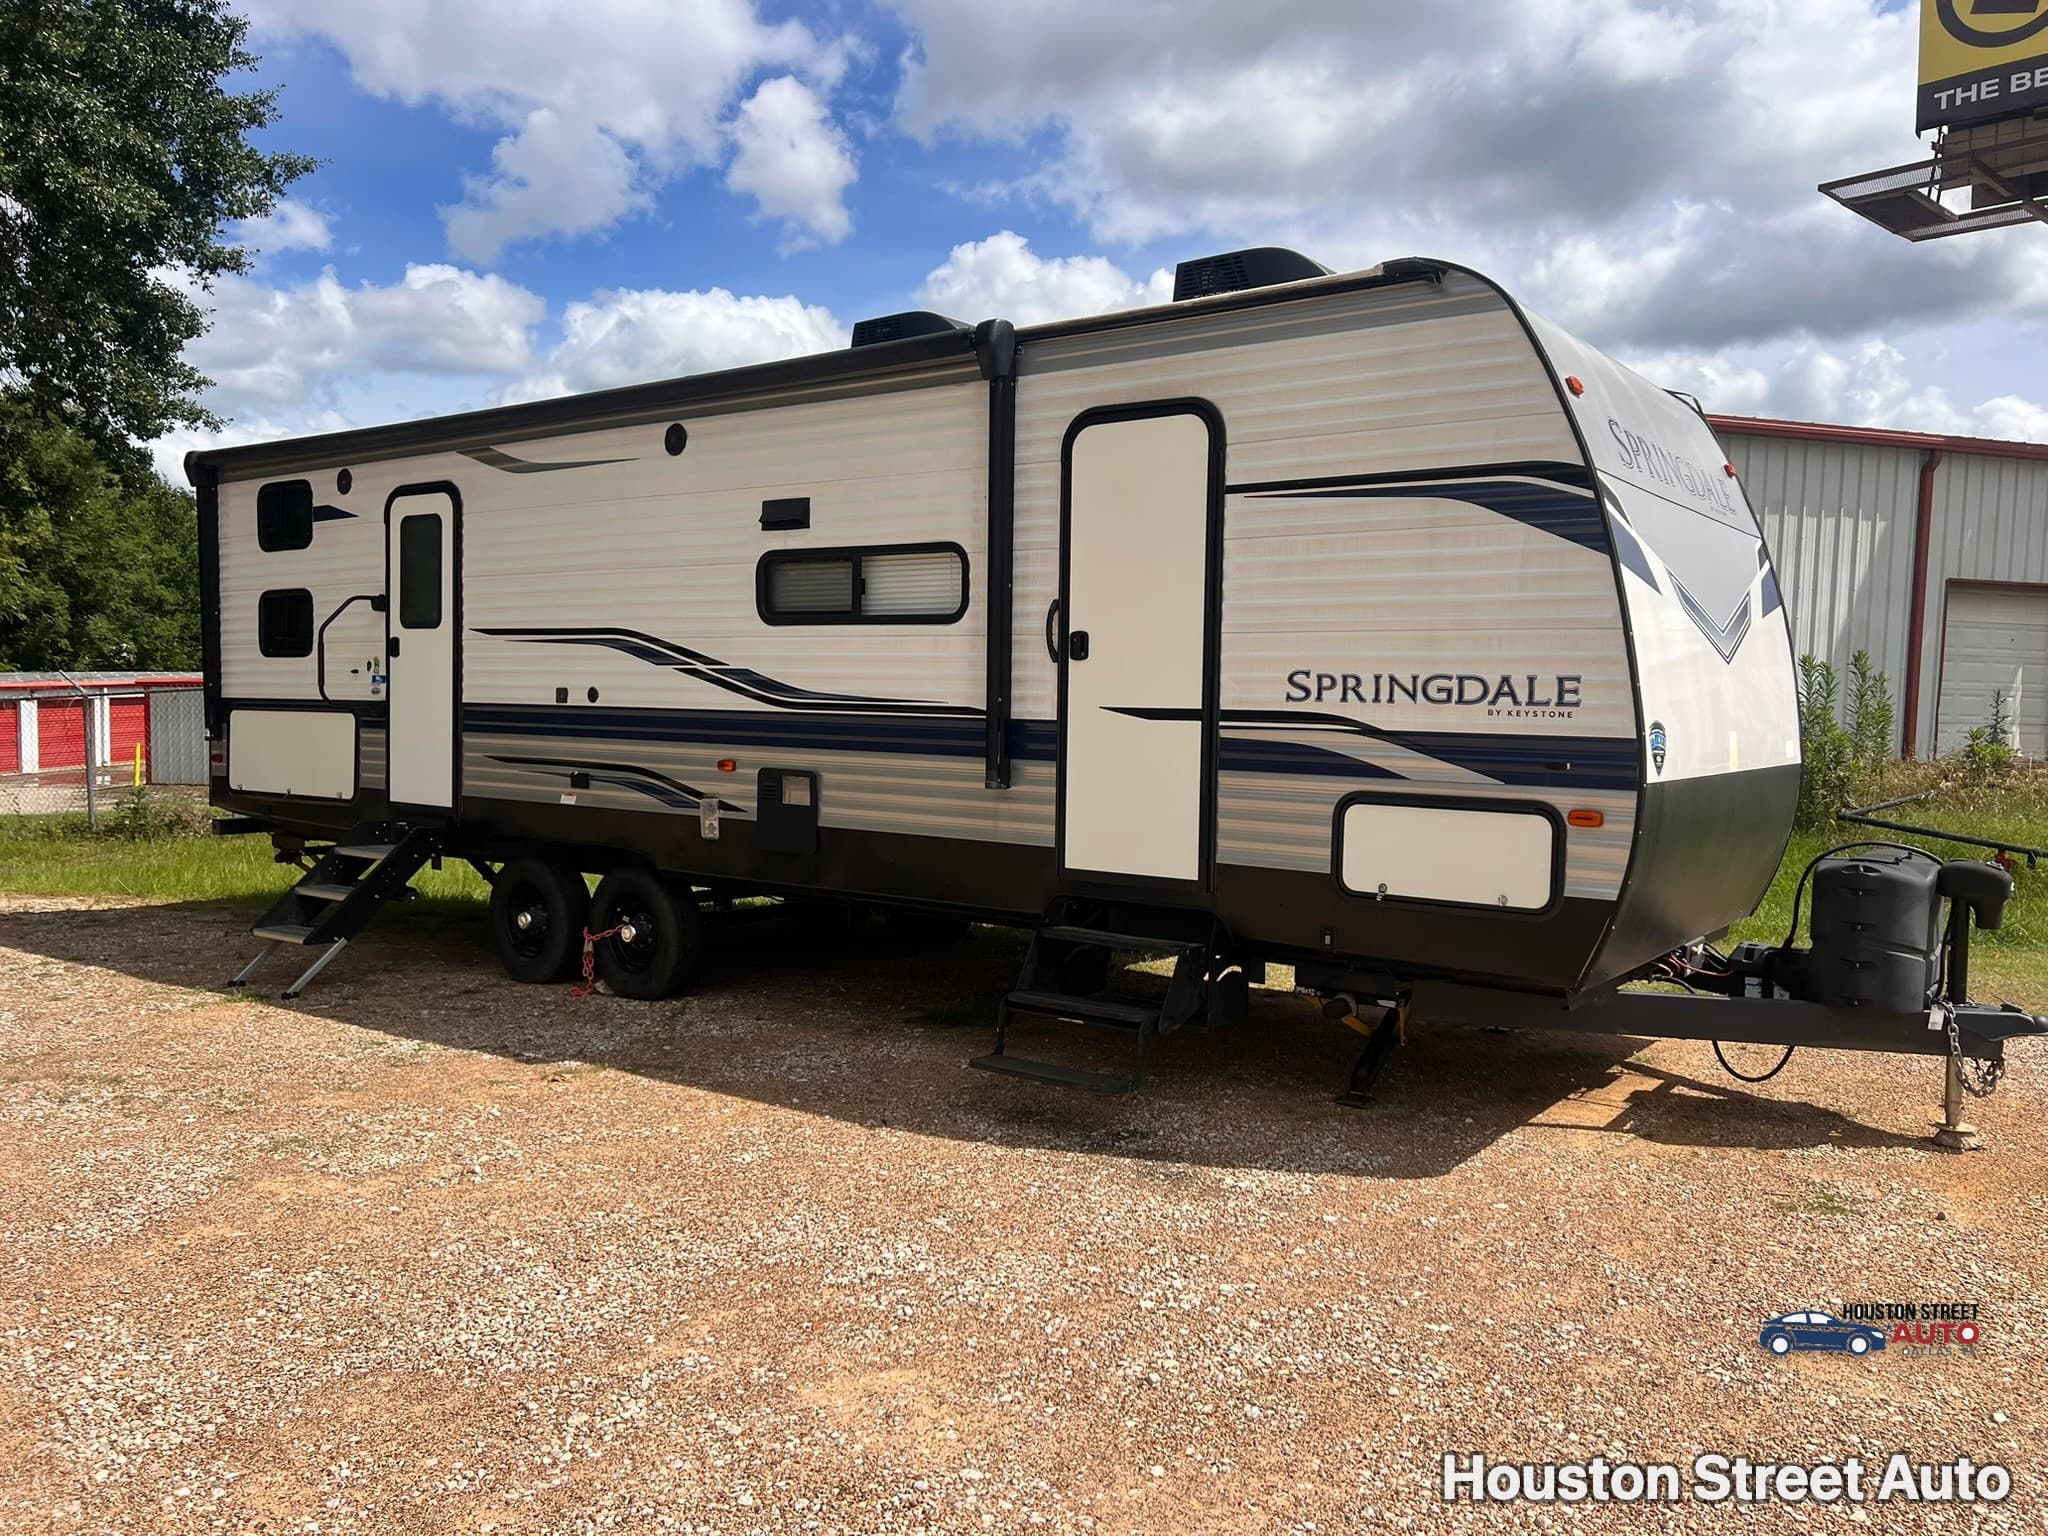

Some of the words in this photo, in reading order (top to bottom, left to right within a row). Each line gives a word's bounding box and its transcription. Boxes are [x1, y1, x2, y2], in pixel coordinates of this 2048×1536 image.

[1933, 78, 2000, 110] THE
[1608, 417, 1737, 515] SPRINGDALE
[1285, 669, 1583, 708] SPRINGDALE
[1487, 708, 1502, 716] BY
[1507, 709, 1574, 719] KEYSTONE
